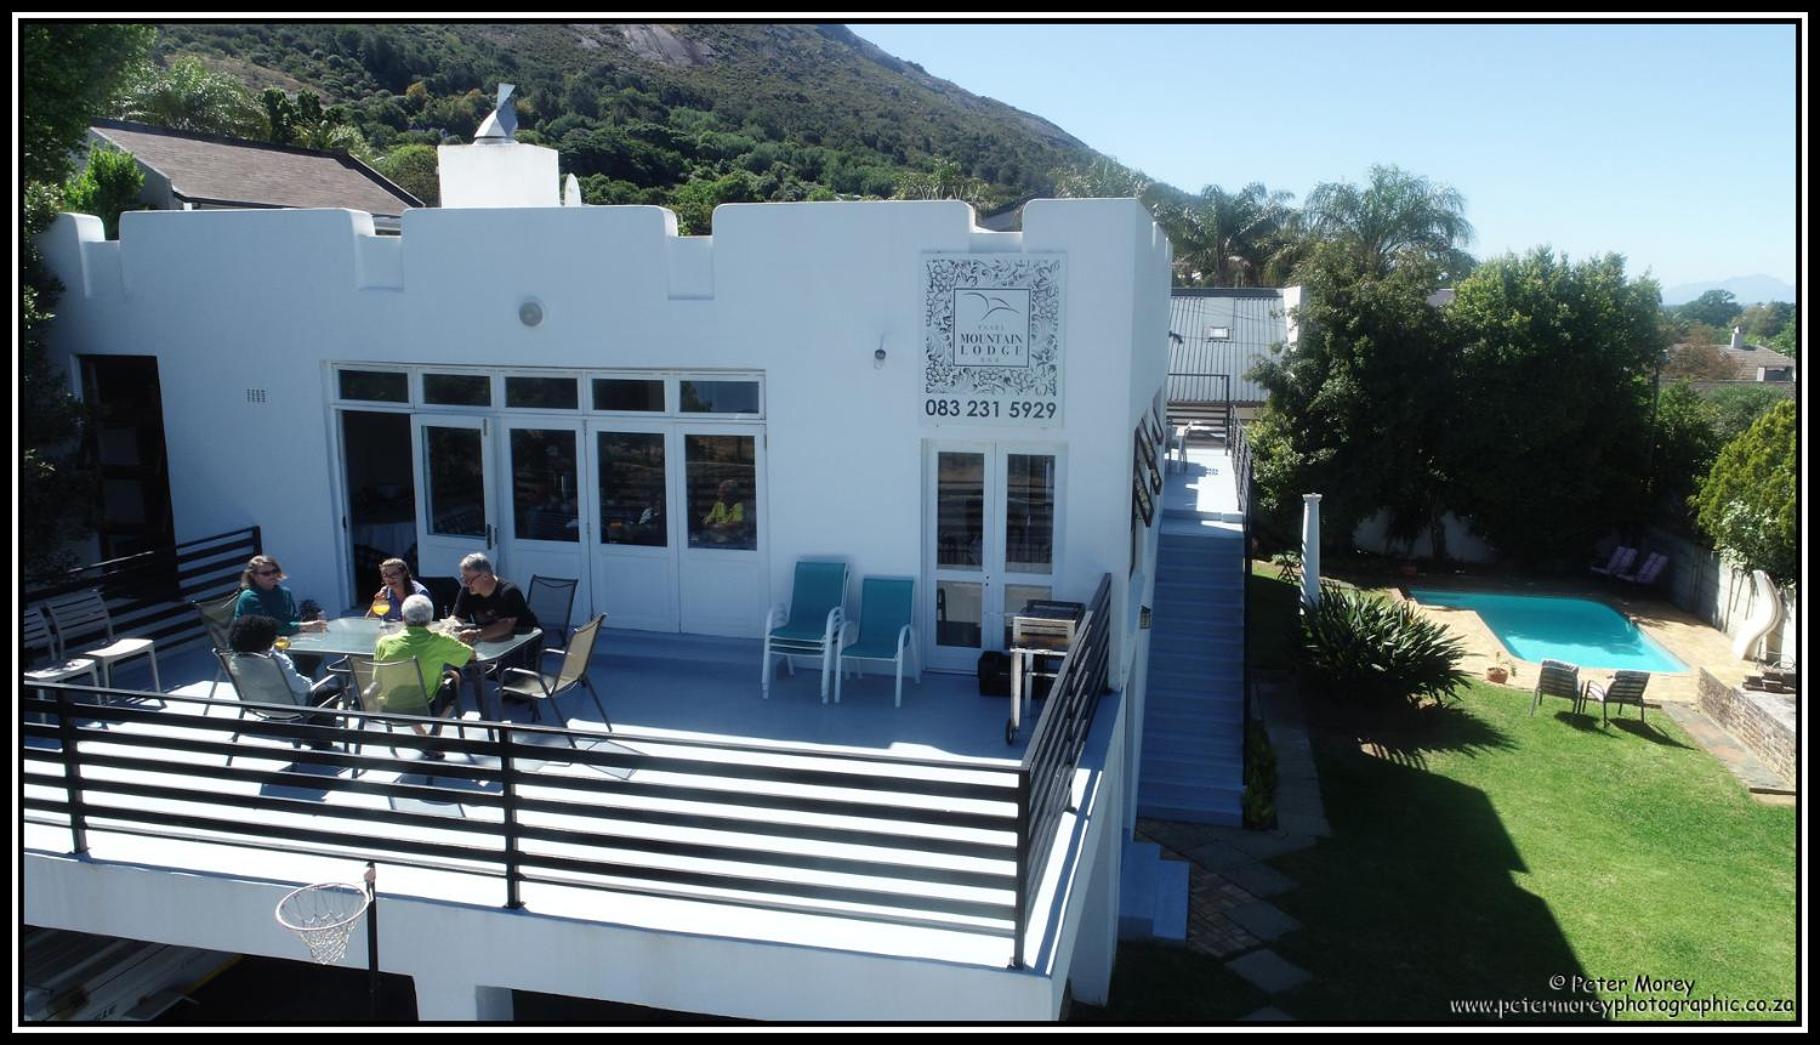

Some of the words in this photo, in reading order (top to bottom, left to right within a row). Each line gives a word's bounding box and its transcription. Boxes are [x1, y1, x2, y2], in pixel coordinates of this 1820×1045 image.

[960, 333, 1023, 344] MOUNTAIN
[960, 345, 1022, 356] LODGE
[925, 399, 960, 417] 083
[966, 401, 1000, 418] 231
[1009, 401, 1057, 419] 5929
